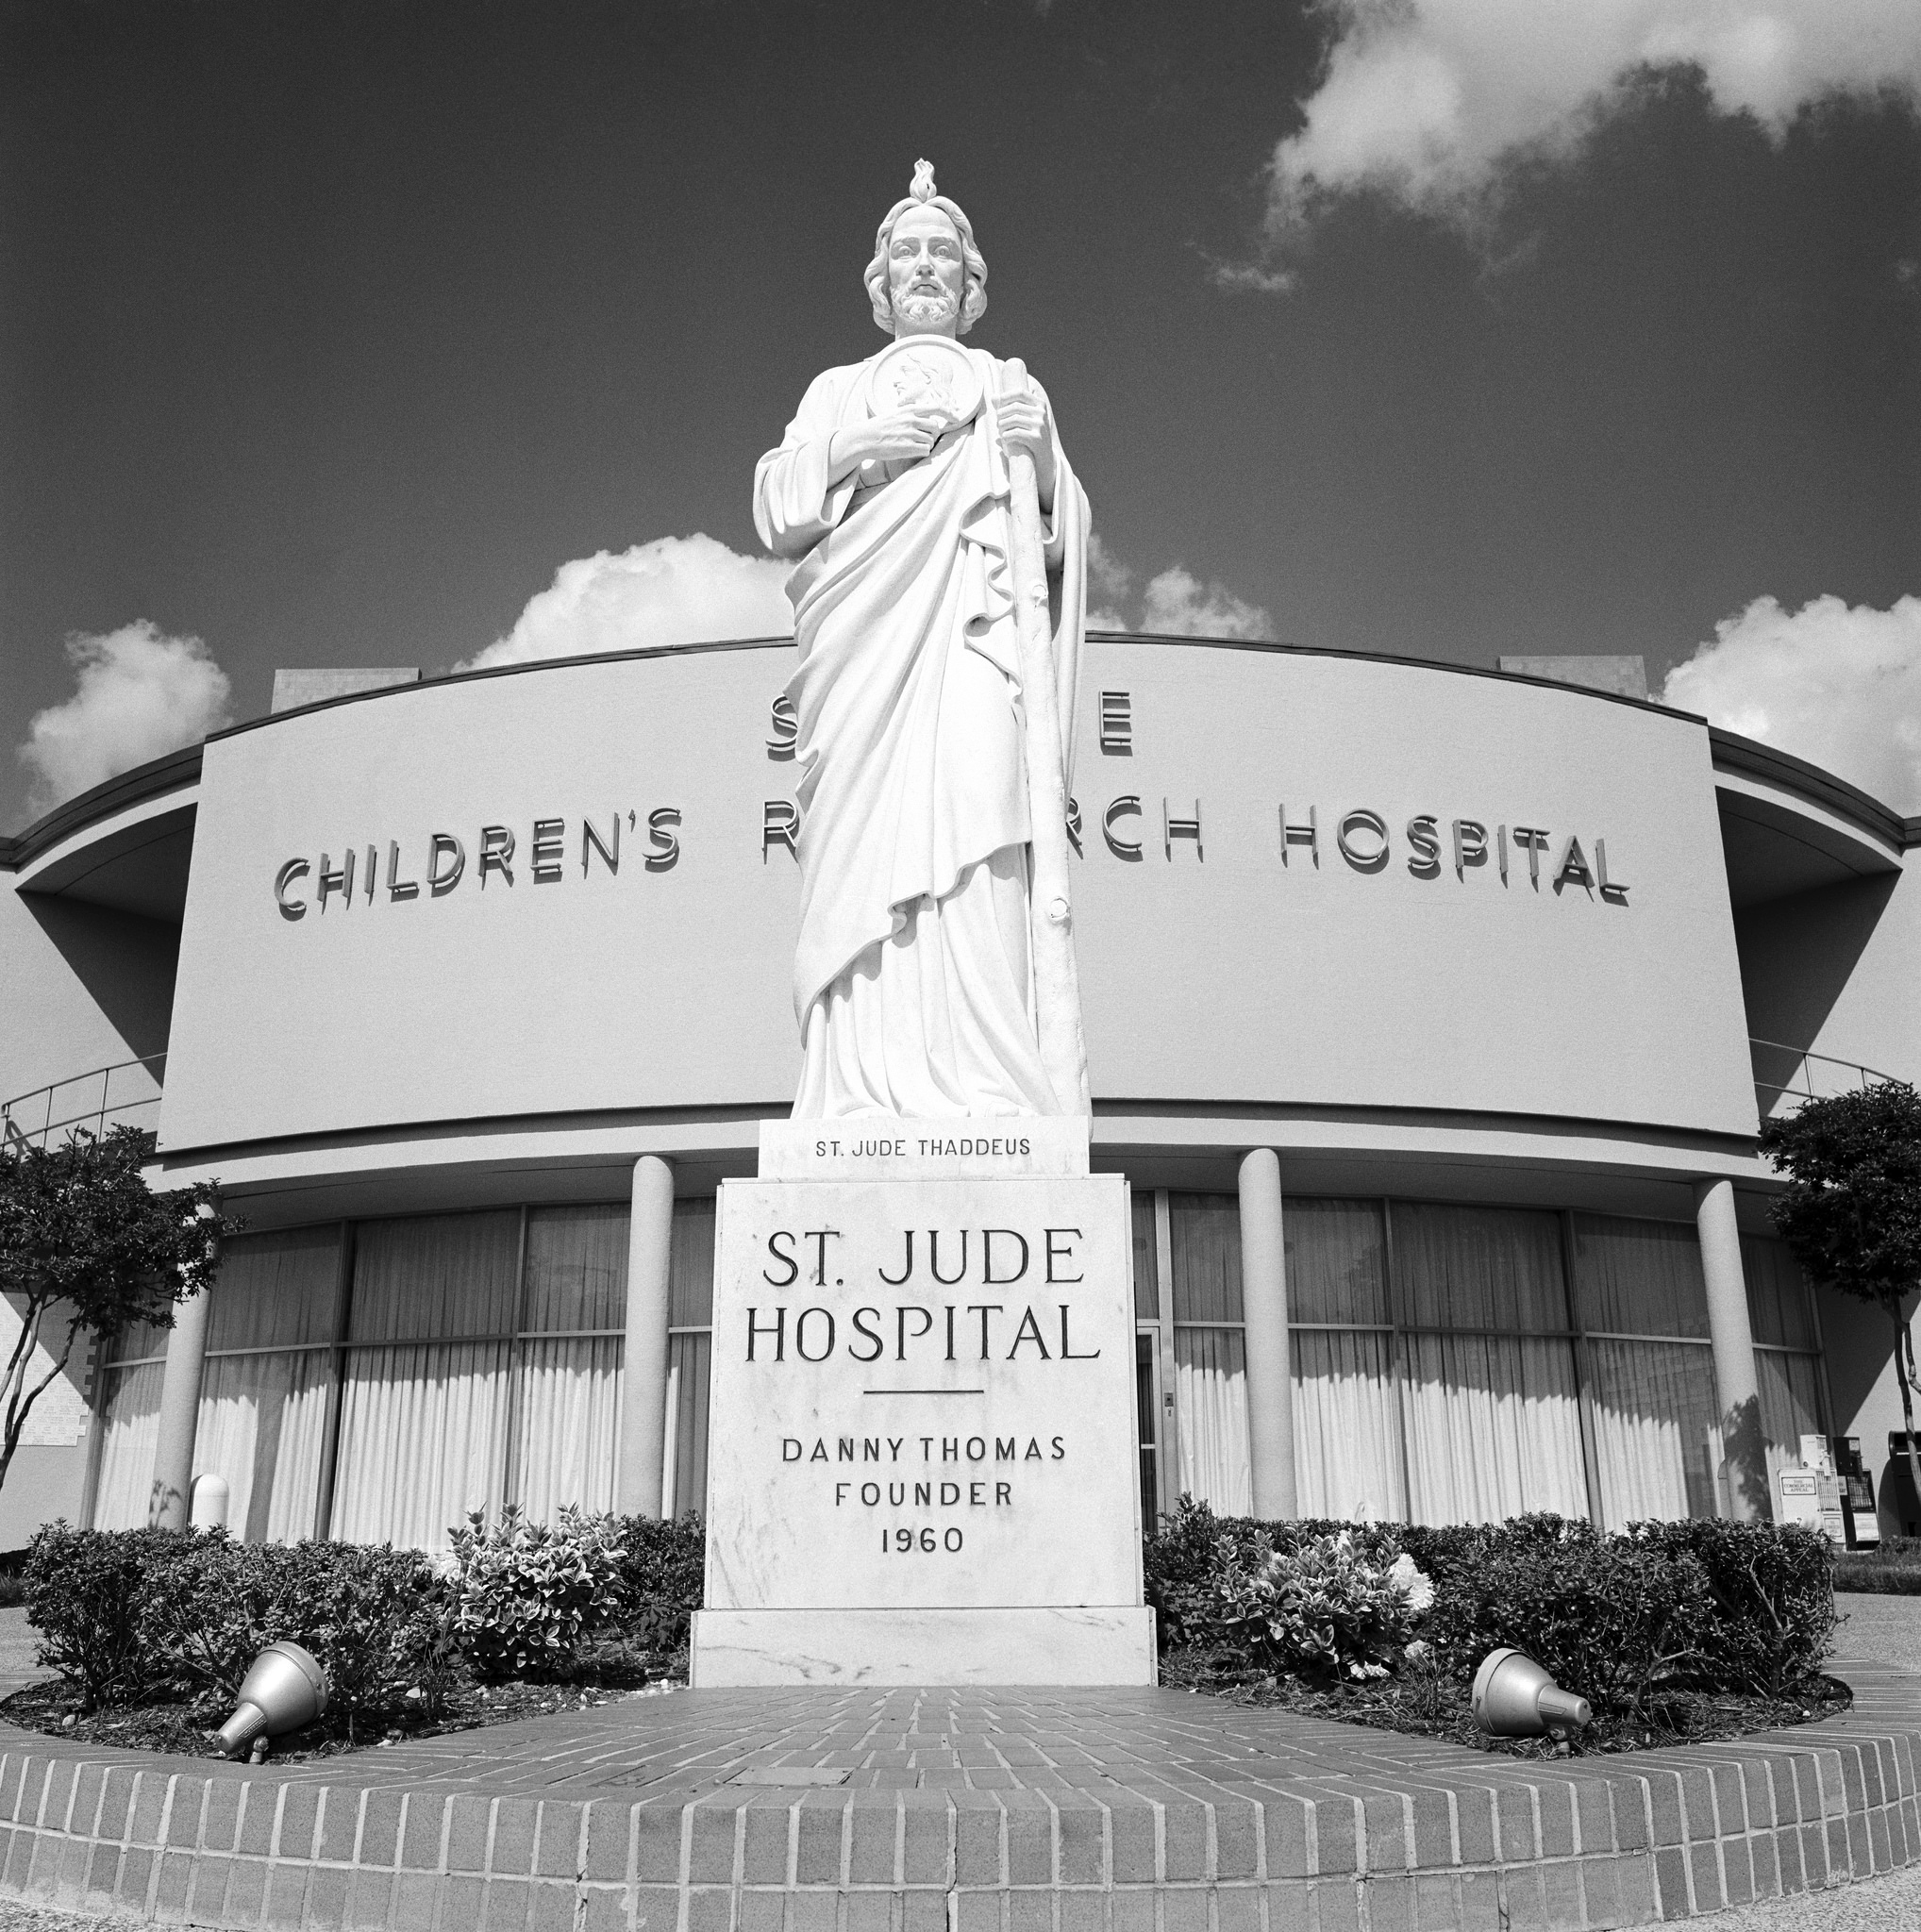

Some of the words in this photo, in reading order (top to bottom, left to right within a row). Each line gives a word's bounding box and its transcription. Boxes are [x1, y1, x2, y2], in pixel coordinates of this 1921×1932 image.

[274, 808, 682, 913] CHILDREN'S
[1278, 803, 1630, 896] HOSPITAL
[815, 1140, 844, 1158] ST.
[851, 1139, 907, 1158] JUDE
[918, 1138, 1031, 1157] THADDEUS
[762, 1230, 844, 1288] ST.
[878, 1228, 1084, 1286] JUDE
[745, 1305, 1101, 1362] HOSPITAL
[781, 1437, 905, 1462] DANNY
[919, 1436, 1066, 1461] THOMAS
[835, 1481, 1012, 1507] FOUNDER
[881, 1526, 964, 1554] 1960
